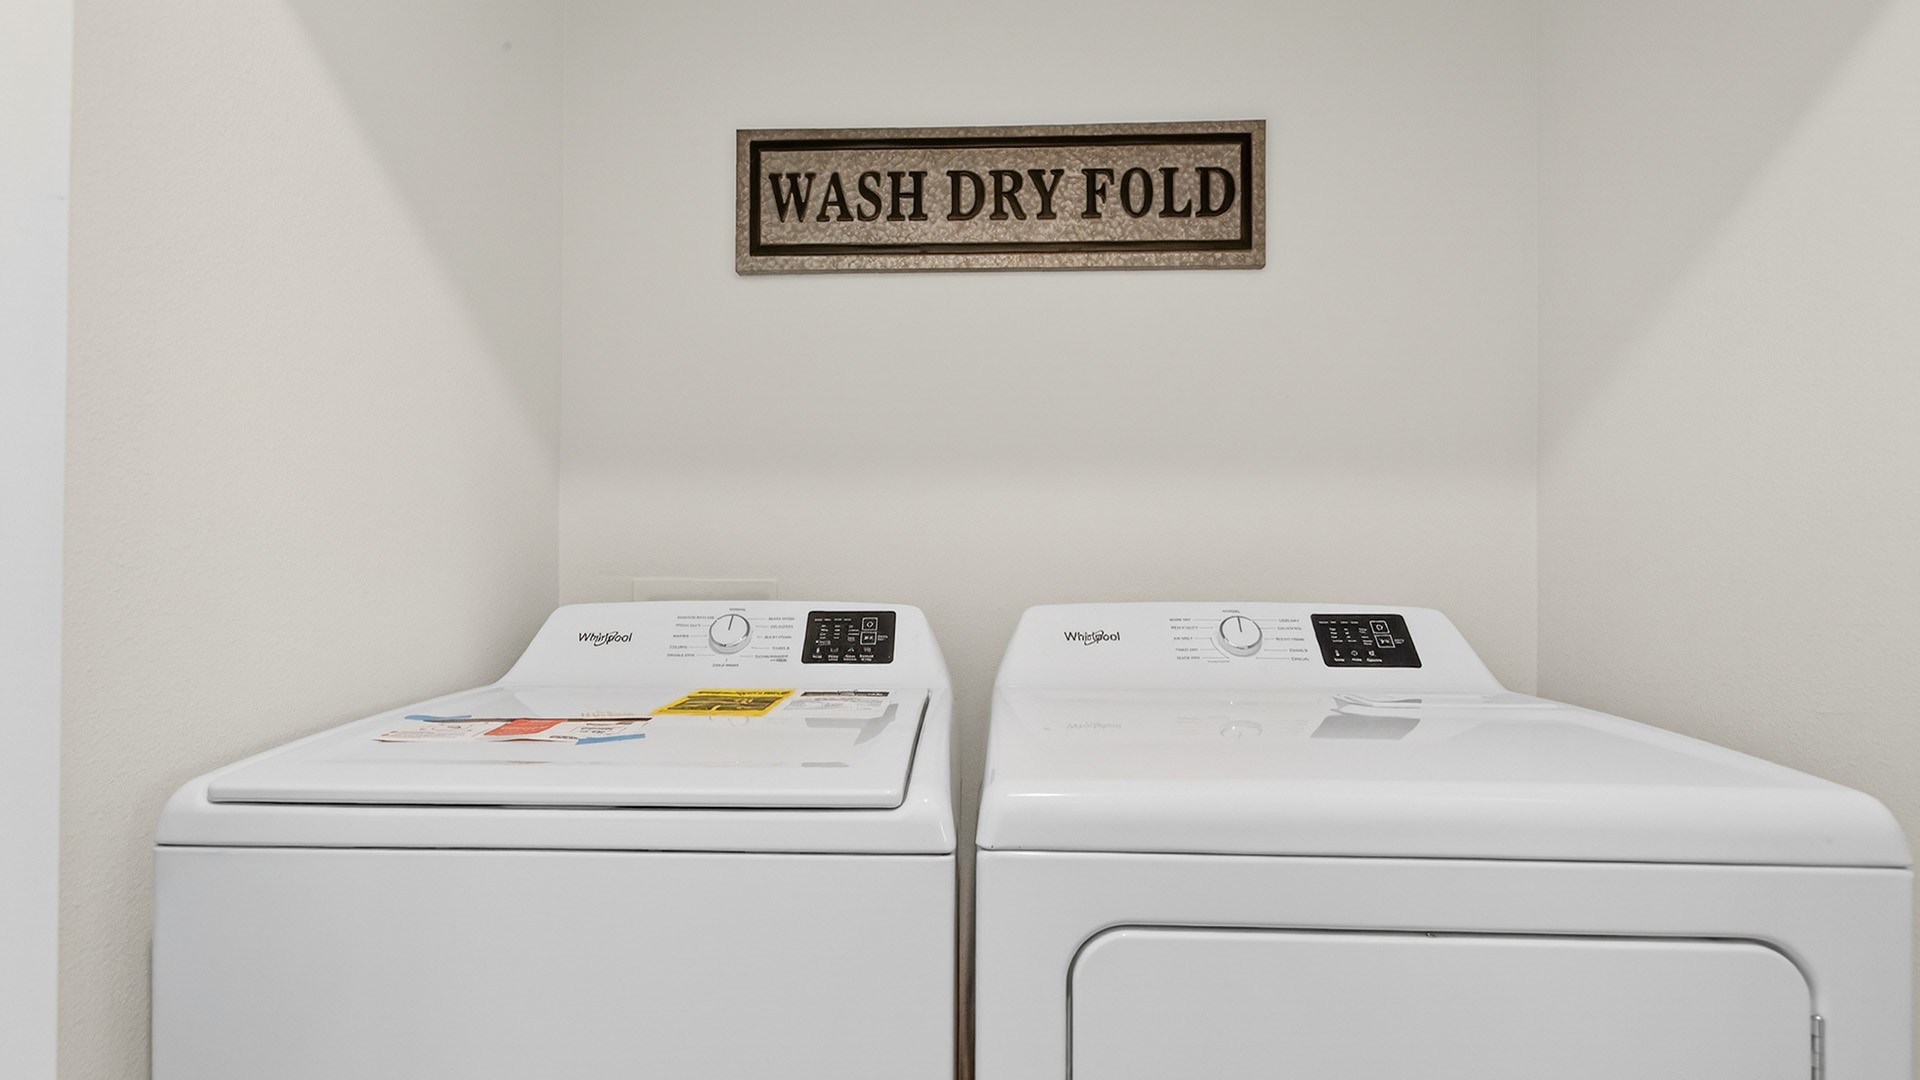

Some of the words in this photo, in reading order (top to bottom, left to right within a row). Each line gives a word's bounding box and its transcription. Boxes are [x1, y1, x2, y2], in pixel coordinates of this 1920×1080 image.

[768, 170, 928, 223] WASH
[946, 168, 1066, 221] DRY
[1081, 166, 1236, 219] FOLD
[578, 631, 633, 647] Whirlpool
[1063, 630, 1121, 646] Whirlpool
